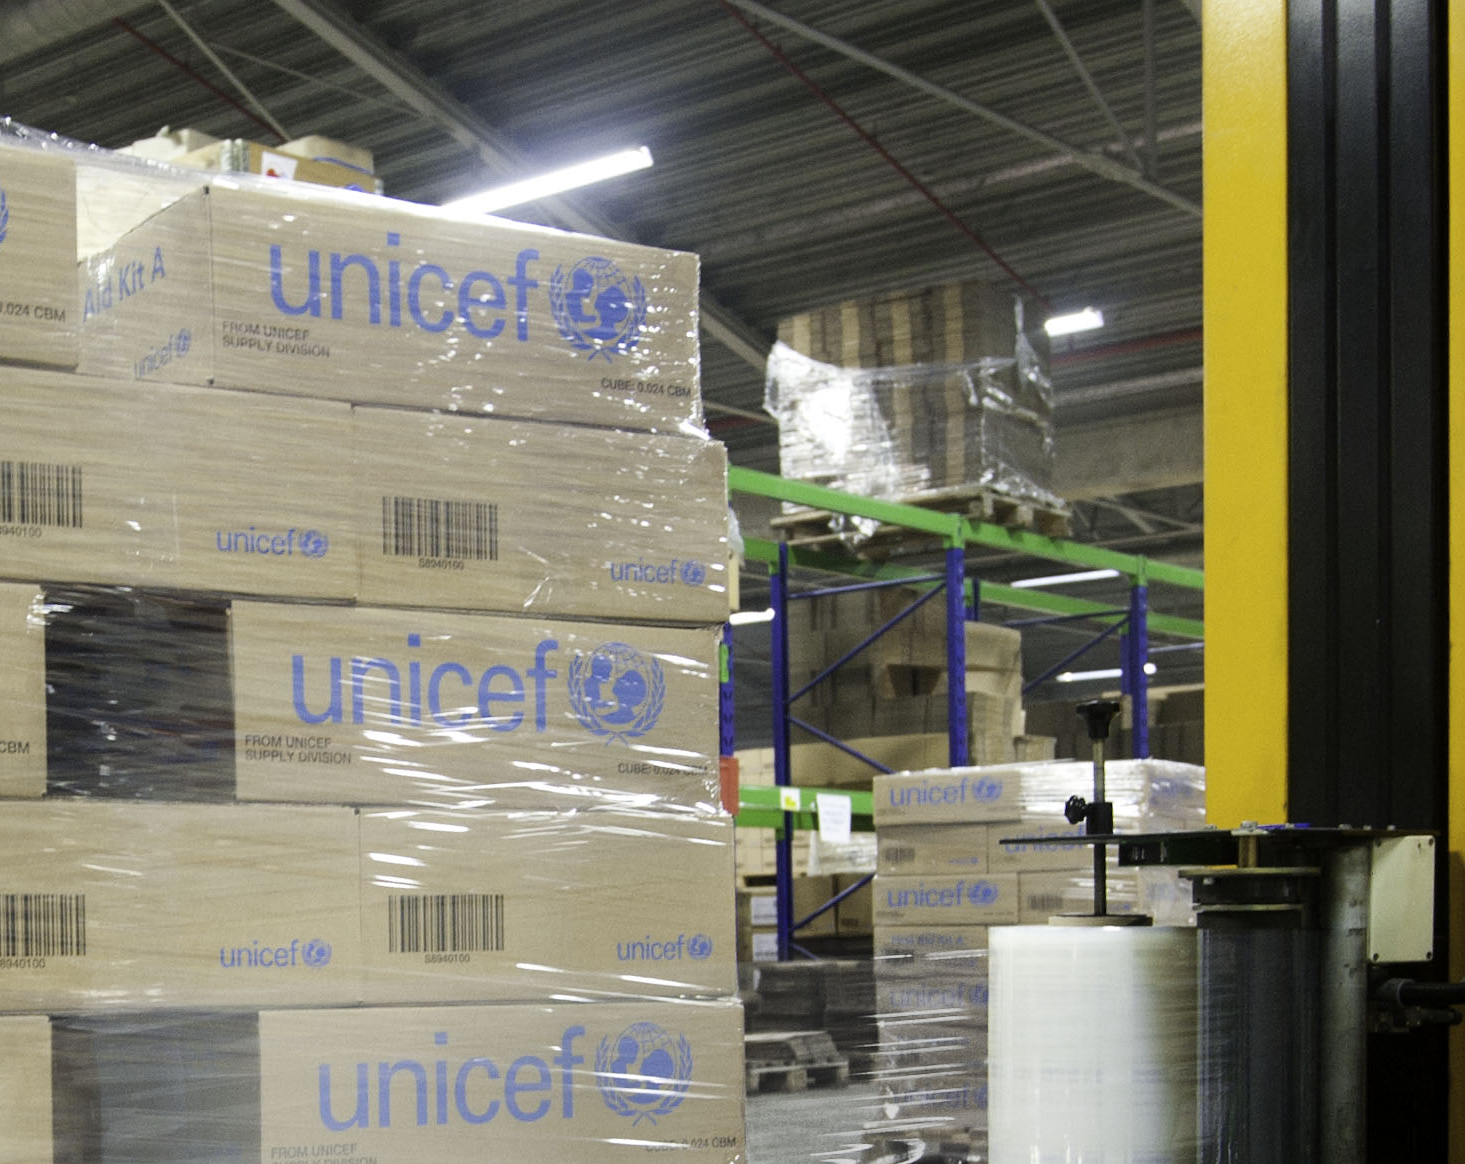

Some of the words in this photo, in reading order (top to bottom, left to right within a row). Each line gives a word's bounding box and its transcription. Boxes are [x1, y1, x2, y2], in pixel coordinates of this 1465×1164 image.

[118, 262, 145, 301] Kit
[150, 246, 166, 284] A
[269, 232, 539, 342] unicef
[34, 304, 66, 322] CBM
[222, 321, 260, 336] FROM
[263, 325, 310, 339] UNICEF
[222, 336, 273, 352] SUPPLY
[276, 342, 331, 358] DIVISION
[667, 384, 692, 398] CBM
[216, 526, 296, 556] unicef
[610, 557, 678, 584] unicef
[291, 634, 558, 733] unicef
[244, 734, 282, 747] FROM
[285, 736, 332, 749] UNICEF
[245, 749, 295, 761] SUPPLY
[298, 751, 352, 764] DIVISION
[889, 775, 968, 807] unicef
[887, 881, 965, 908] unicef
[220, 939, 300, 967] unicef
[617, 934, 685, 961] unicef
[318, 1025, 585, 1132] unicef
[271, 1146, 308, 1159] FROM
[311, 1142, 358, 1157] UNICEF
[712, 1136, 736, 1148] CBM
